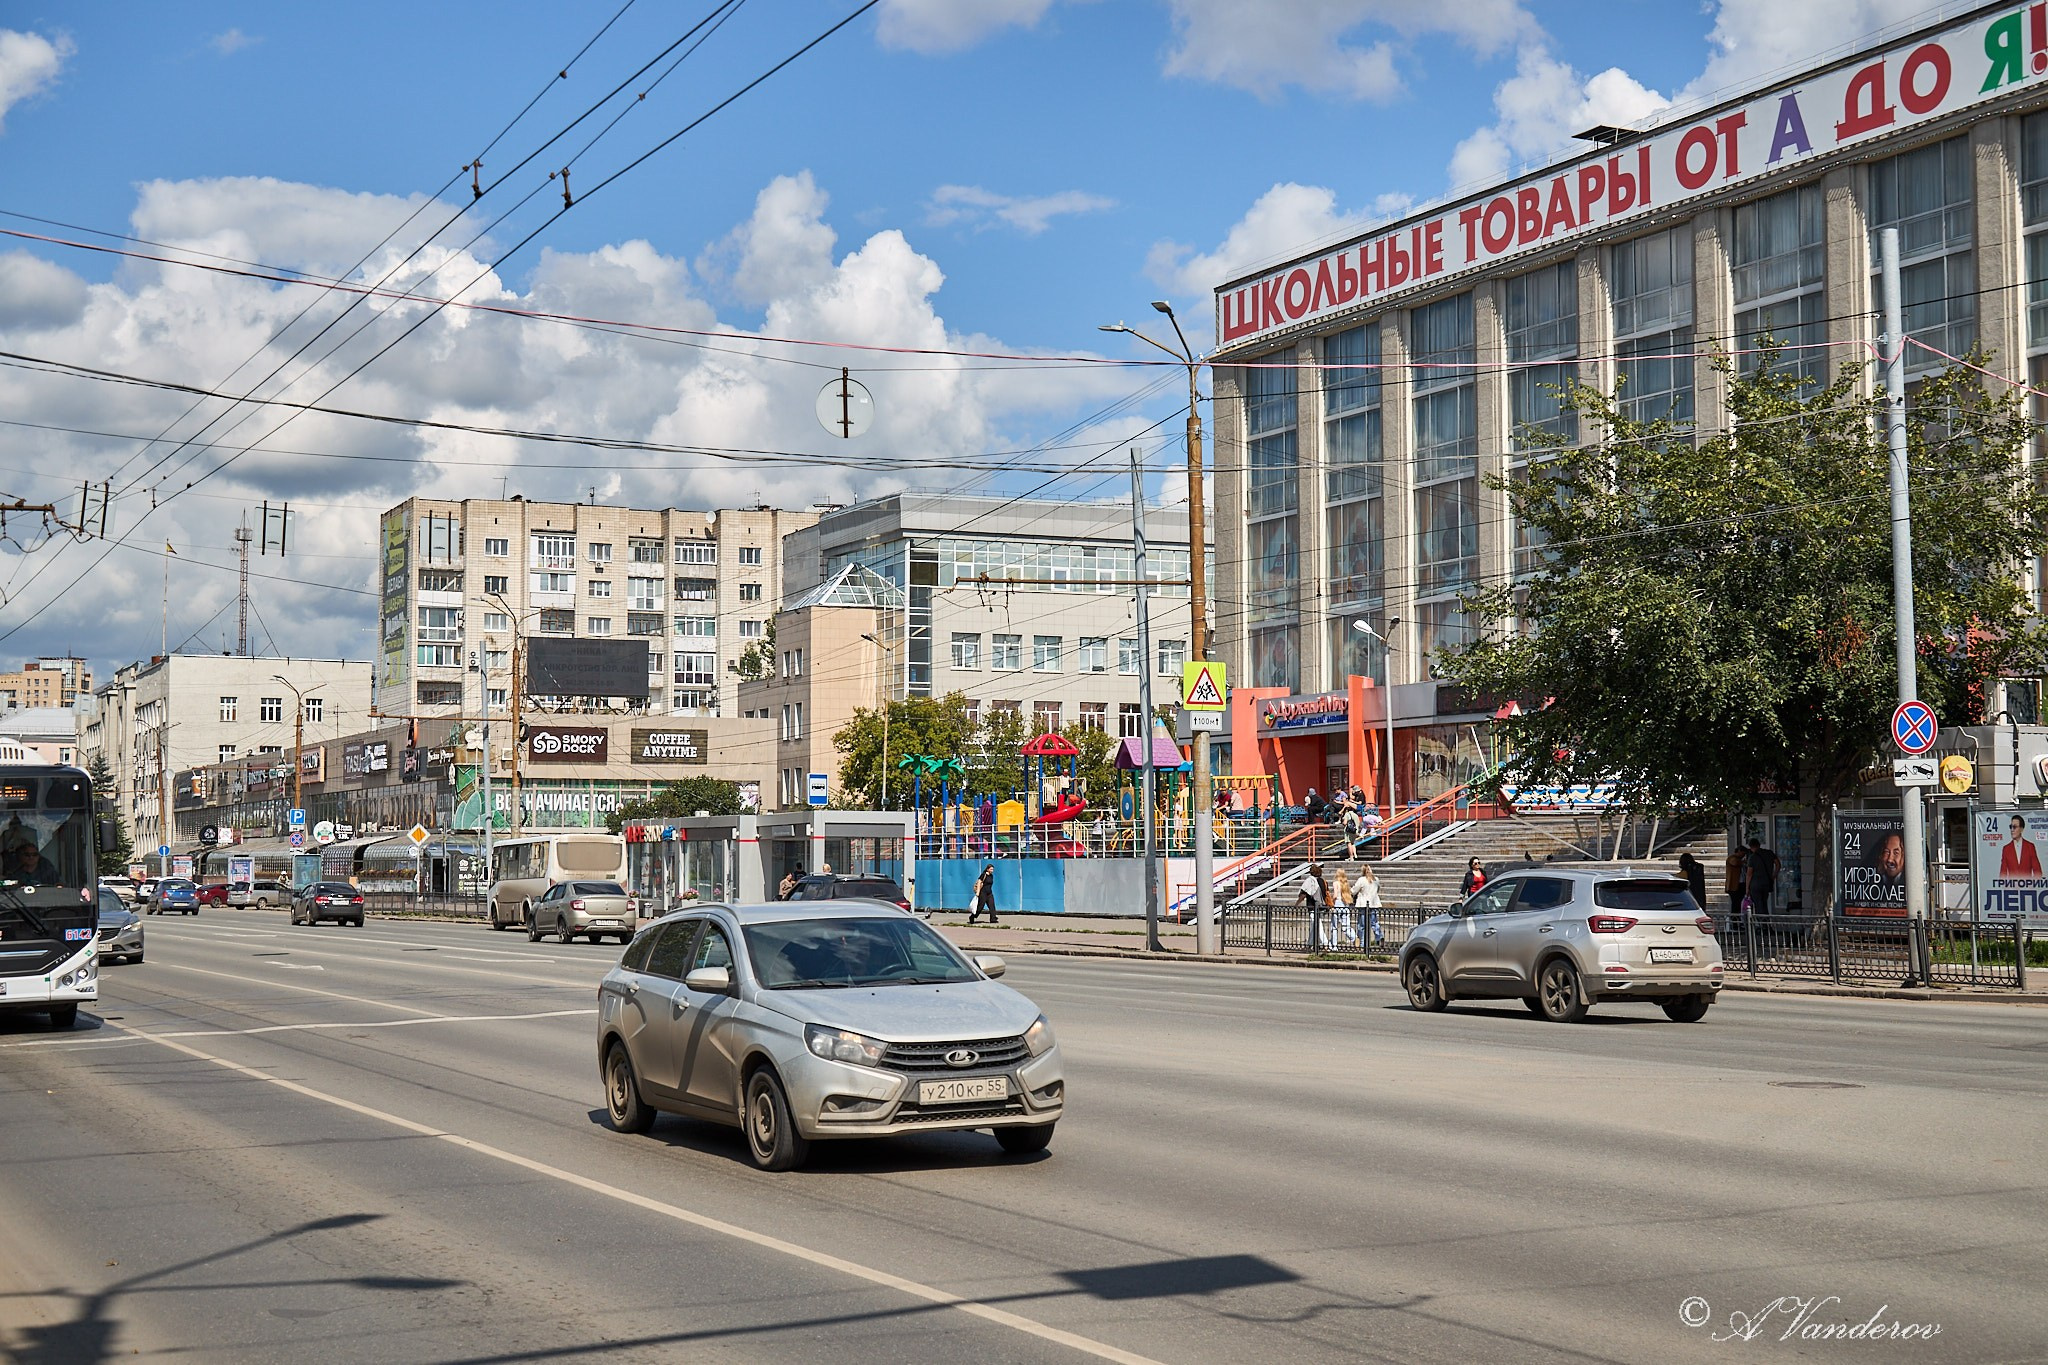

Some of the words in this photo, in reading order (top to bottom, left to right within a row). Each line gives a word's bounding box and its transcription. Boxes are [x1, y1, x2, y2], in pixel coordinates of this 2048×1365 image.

[1223, 218, 1444, 343] ШКОЛЬНЫЕ
[1459, 142, 1652, 264] ТОВАРЫ
[1675, 108, 1747, 191] ОТ
[1764, 88, 1814, 174] А
[1836, 40, 1951, 145] ДО
[562, 734, 604, 746] SMOKY
[649, 734, 691, 746] COFFEE
[562, 745, 596, 755] DOCK
[642, 745, 698, 758] ANYTIME
[1843, 820, 1892, 830] МУЗЫКАЛЬНЫЙ
[1986, 816, 1998, 832] 24
[1844, 832, 1861, 850] 24
[1844, 867, 1881, 884] ИГОРЬ
[1993, 876, 2048, 889] ГРИГОРИЙ
[1844, 884, 1907, 901] НИКОЛАЕ
[65, 929, 92, 941] 6142
[927, 1083, 984, 1100] У210КР
[987, 1079, 1002, 1092] 55
